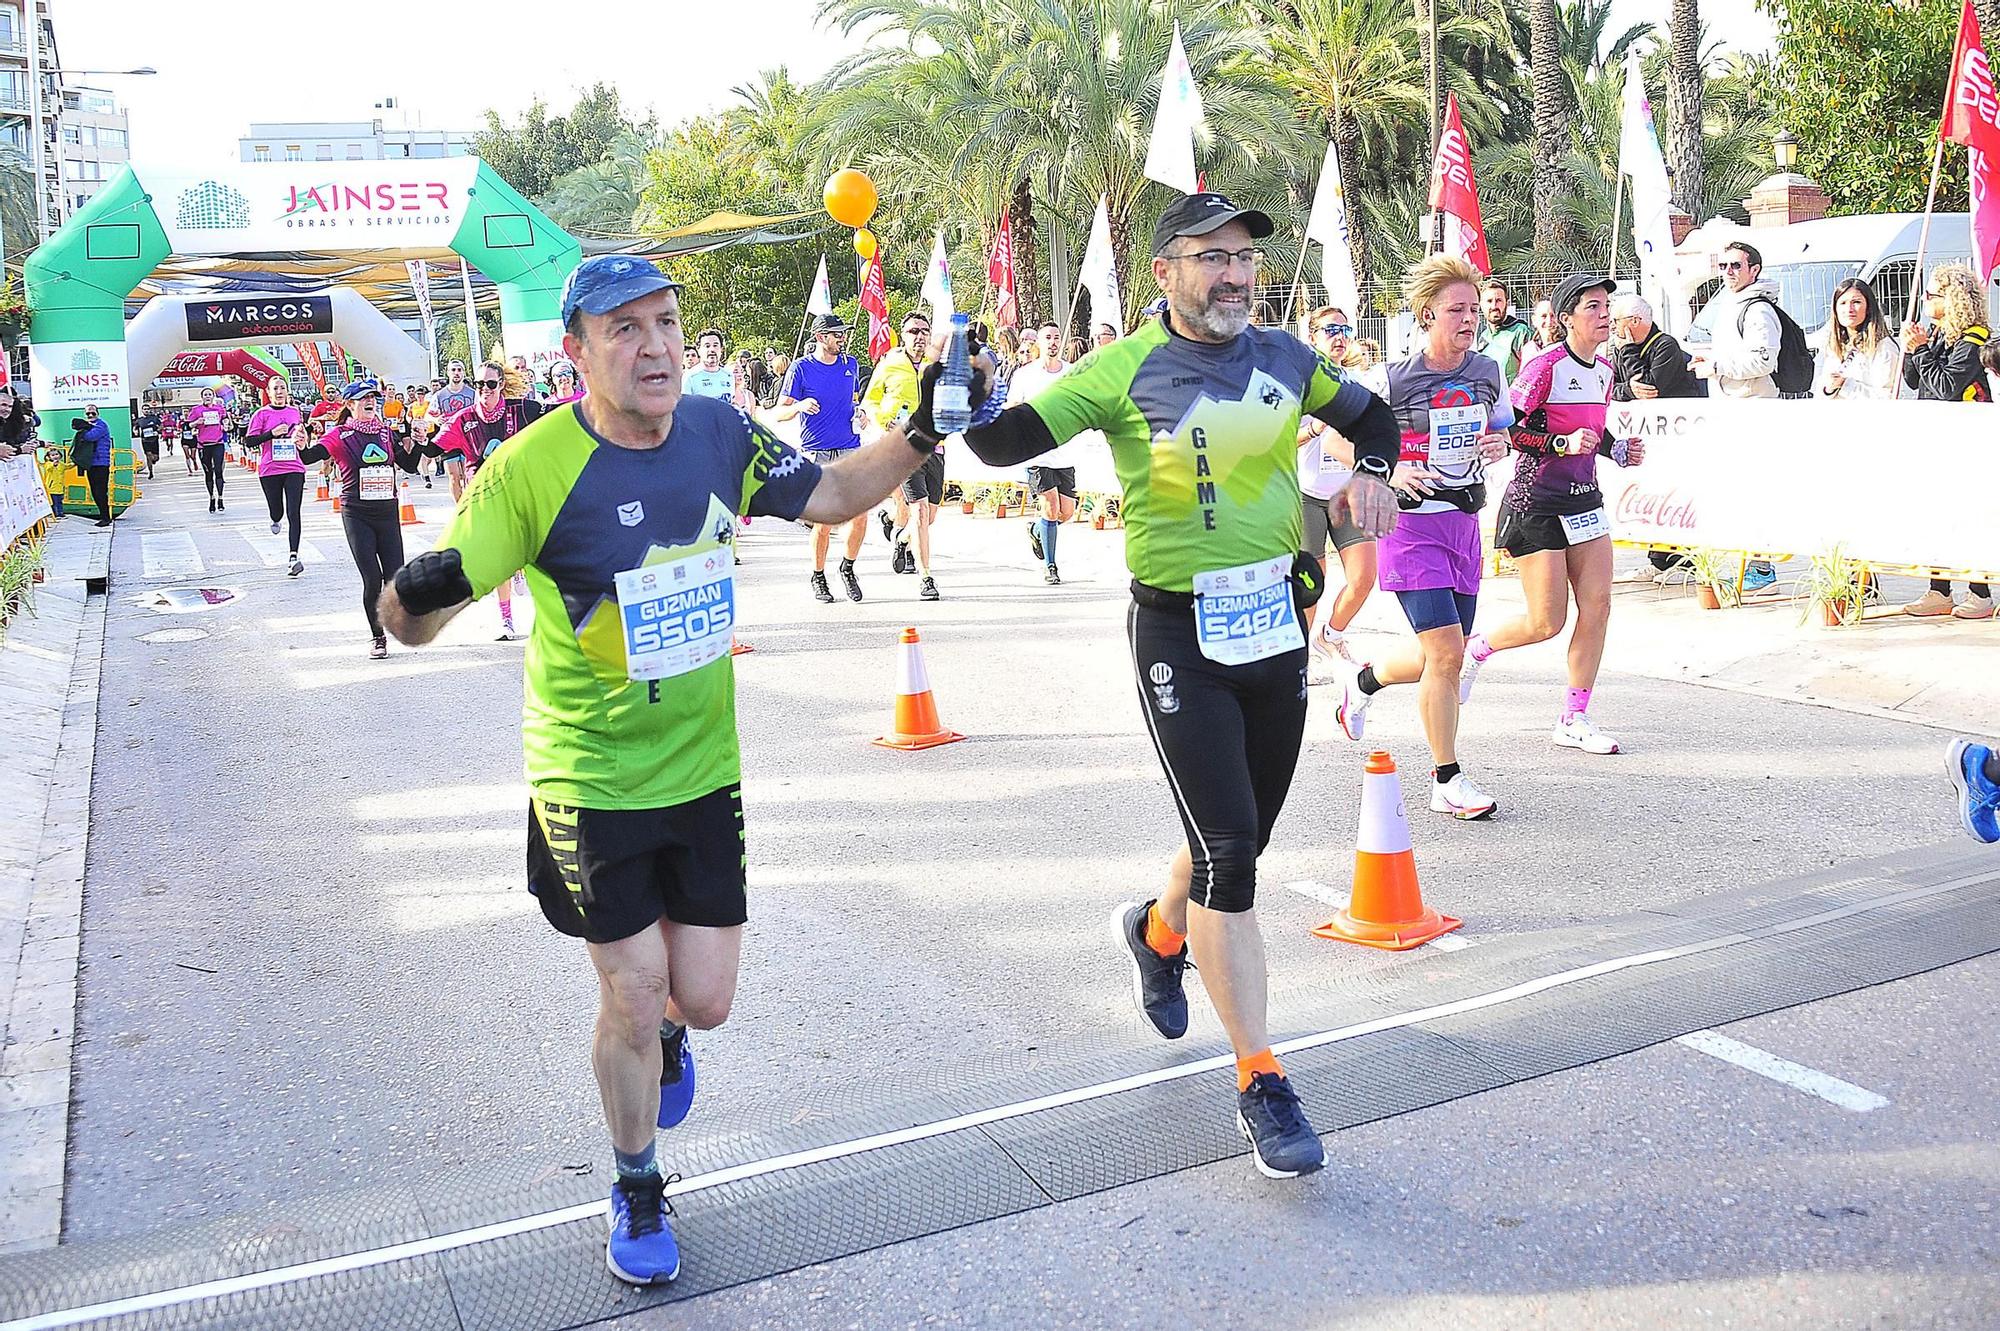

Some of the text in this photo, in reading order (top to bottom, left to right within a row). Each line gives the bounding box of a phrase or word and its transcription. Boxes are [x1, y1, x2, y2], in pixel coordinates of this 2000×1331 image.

[286, 183, 449, 213] JAINSER
[286, 215, 451, 228] OBRAS Y SERVICIOS
[206, 303, 313, 324] MARCOS
[241, 322, 313, 334] automoción
[53, 373, 119, 389] JAINSER
[1191, 427, 1216, 531] GAME
[1567, 512, 1599, 530] 1559
[640, 583, 722, 621] GUZMAN
[1203, 594, 1259, 614] GUZMAN
[633, 601, 732, 654] 5505
[1205, 601, 1287, 642] 5487
